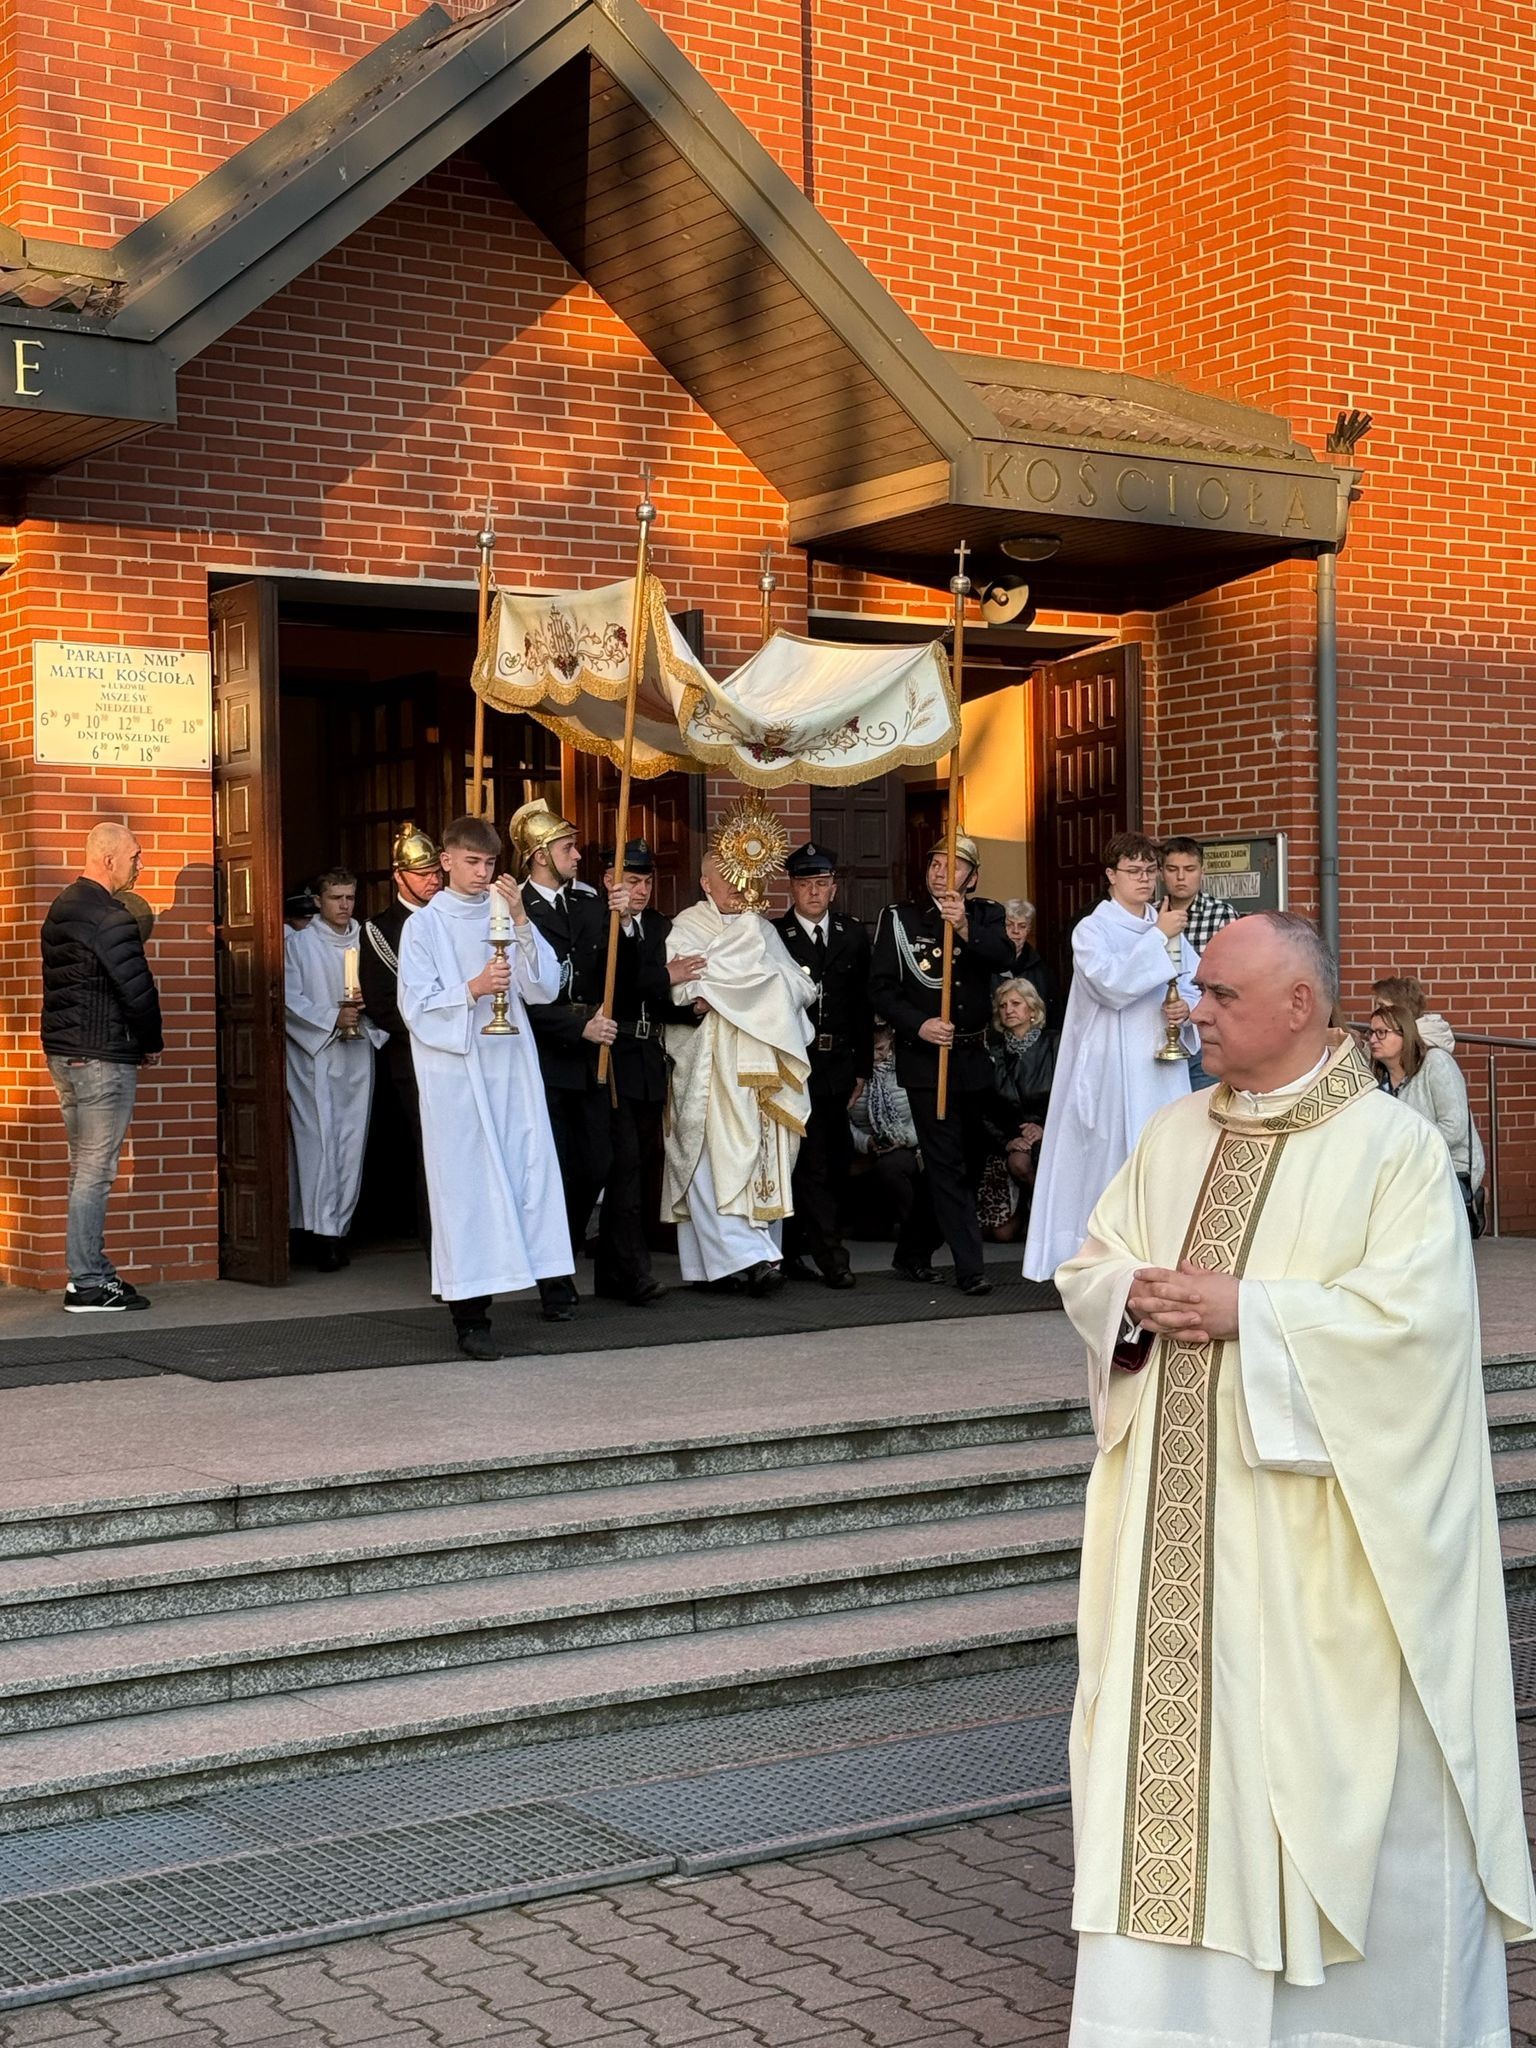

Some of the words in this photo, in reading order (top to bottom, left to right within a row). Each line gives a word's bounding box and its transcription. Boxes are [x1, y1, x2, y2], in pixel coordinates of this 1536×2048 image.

[982, 452, 1312, 530] KOŚCIOŁA
[66, 649, 132, 664] PARAFIA
[143, 653, 179, 667] NMP
[50, 665, 104, 680] MATKI
[116, 668, 195, 685] KOŚCIOŁA
[95, 703, 153, 714] NIEDZIELE
[78, 731, 99, 740] DNI
[100, 731, 171, 744] POWSZEDNIE
